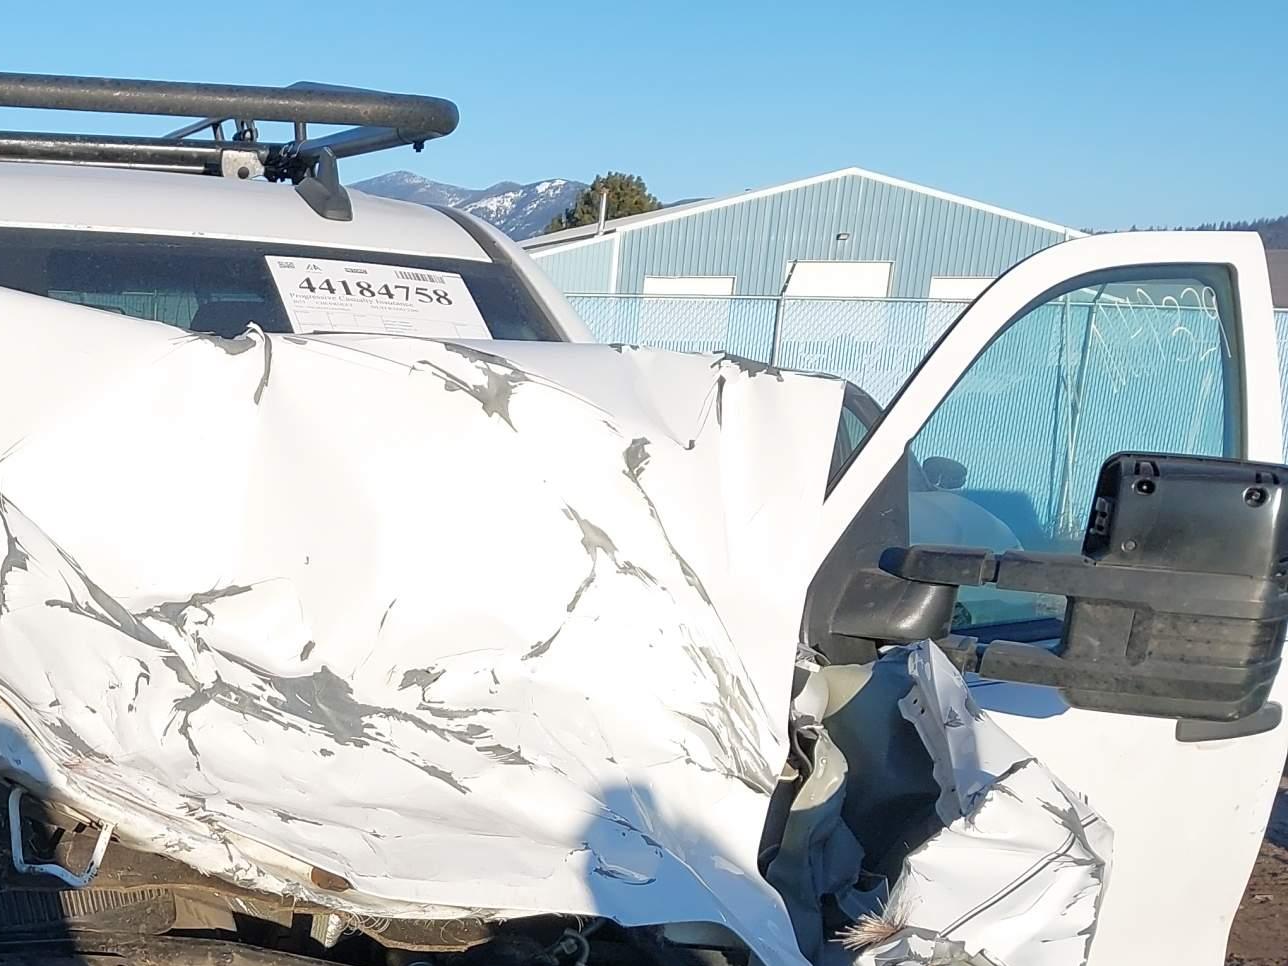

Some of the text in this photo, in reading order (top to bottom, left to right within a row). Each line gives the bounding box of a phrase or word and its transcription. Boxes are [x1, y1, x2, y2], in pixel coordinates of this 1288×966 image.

[289, 292, 414, 308] Progressive Casualty Insurance
[298, 276, 453, 306] 44184758
